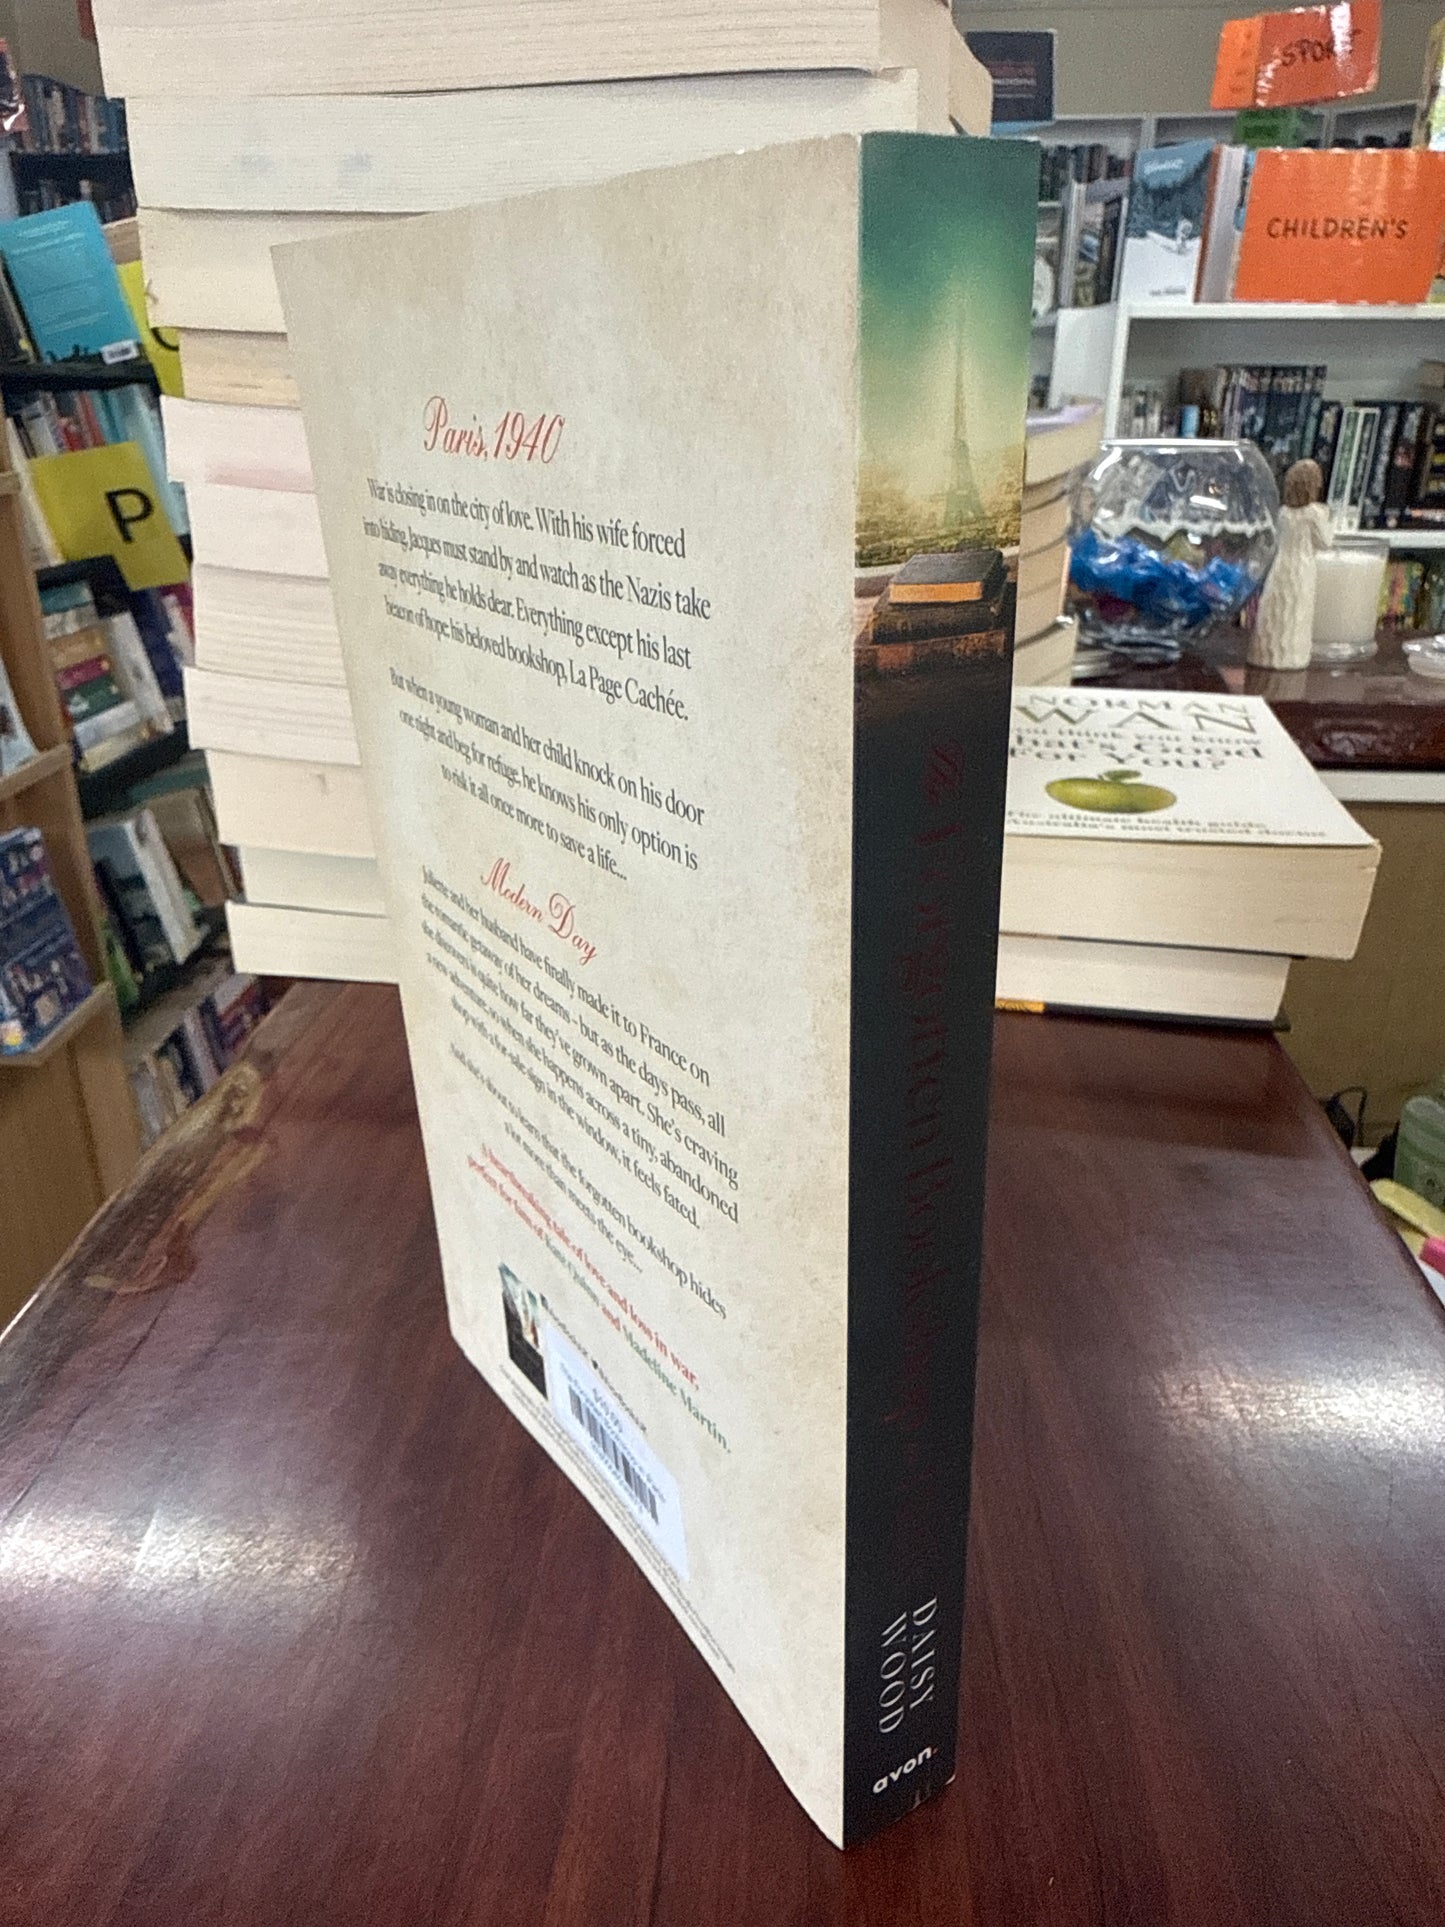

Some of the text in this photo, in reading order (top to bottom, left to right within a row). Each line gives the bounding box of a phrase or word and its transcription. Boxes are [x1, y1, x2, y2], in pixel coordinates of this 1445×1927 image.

[1266, 217, 1409, 240] CHILDREN'S
[423, 395, 566, 464] Paris, 1940
[104, 487, 154, 544] P
[437, 497, 450, 515] on
[451, 492, 468, 518] the
[470, 497, 490, 530] city
[492, 500, 505, 526] of
[505, 501, 534, 531] love.
[535, 507, 571, 538] With
[571, 511, 594, 543] his
[596, 518, 630, 548] wife
[631, 520, 686, 559] forced
[457, 580, 486, 609] holds
[487, 589, 514, 618] dear.
[516, 597, 584, 648] Everything
[586, 623, 633, 660] except
[636, 628, 660, 661] his
[662, 634, 692, 669] last
[469, 545, 498, 570] stand
[498, 545, 514, 581] by
[516, 553, 538, 580] and
[539, 561, 579, 590] watch
[582, 572, 597, 594] as
[599, 568, 624, 600] the
[626, 575, 672, 612] Nazis
[675, 586, 711, 620] take
[464, 623, 505, 659] beloved
[507, 637, 568, 687] bookshop,
[569, 658, 588, 687] La
[589, 664, 622, 704] Page
[625, 677, 689, 720] Cachée.
[1029, 694, 1248, 714] NORMAN
[463, 706, 499, 737] woman
[500, 724, 521, 747] and
[521, 726, 541, 756] her
[543, 738, 572, 770] child
[573, 749, 616, 789] knock
[618, 776, 638, 799] on
[640, 777, 663, 809] his
[665, 789, 705, 826] door
[1015, 705, 1257, 735] WAN
[1016, 734, 1264, 759] hat's Good
[490, 794, 514, 819] once
[516, 808, 545, 836] more
[546, 822, 559, 843] to
[560, 831, 585, 859] save
[586, 847, 596, 864] a
[522, 766, 536, 793] he
[537, 773, 577, 813] knows
[577, 793, 598, 824] his
[598, 811, 630, 846] only
[631, 826, 682, 864] option
[684, 843, 699, 871] is
[480, 857, 542, 922] Modern
[547, 893, 597, 966] Day
[518, 935, 543, 970] have
[544, 956, 575, 1000] finally
[577, 986, 610, 1020] made
[610, 1004, 621, 1027] it
[622, 1016, 637, 1038] to
[640, 1022, 688, 1071] France
[690, 1062, 710, 1088] on
[533, 981, 571, 1025] dreams
[578, 1014, 600, 1048] but
[600, 1038, 614, 1058] as
[615, 1045, 637, 1074] the
[638, 1061, 669, 1098] days
[670, 1087, 706, 1126] pass,
[707, 1111, 726, 1138] all
[572, 1048, 608, 1088] grown
[609, 1078, 646, 1117] apart.
[647, 1101, 682, 1143] She's
[684, 1134, 738, 1192] craving
[585, 1091, 620, 1130] across
[621, 1120, 631, 1138] a
[631, 1126, 658, 1163] tiny,
[660, 1149, 738, 1224] abandoned
[621, 1147, 632, 1173] it
[633, 1160, 662, 1198] feels
[663, 1185, 701, 1230] fated.
[626, 1214, 688, 1289] bookshop
[689, 1272, 726, 1320] hides
[879, 1610, 908, 1735] WOOD
[910, 1596, 938, 1711] DAISY
